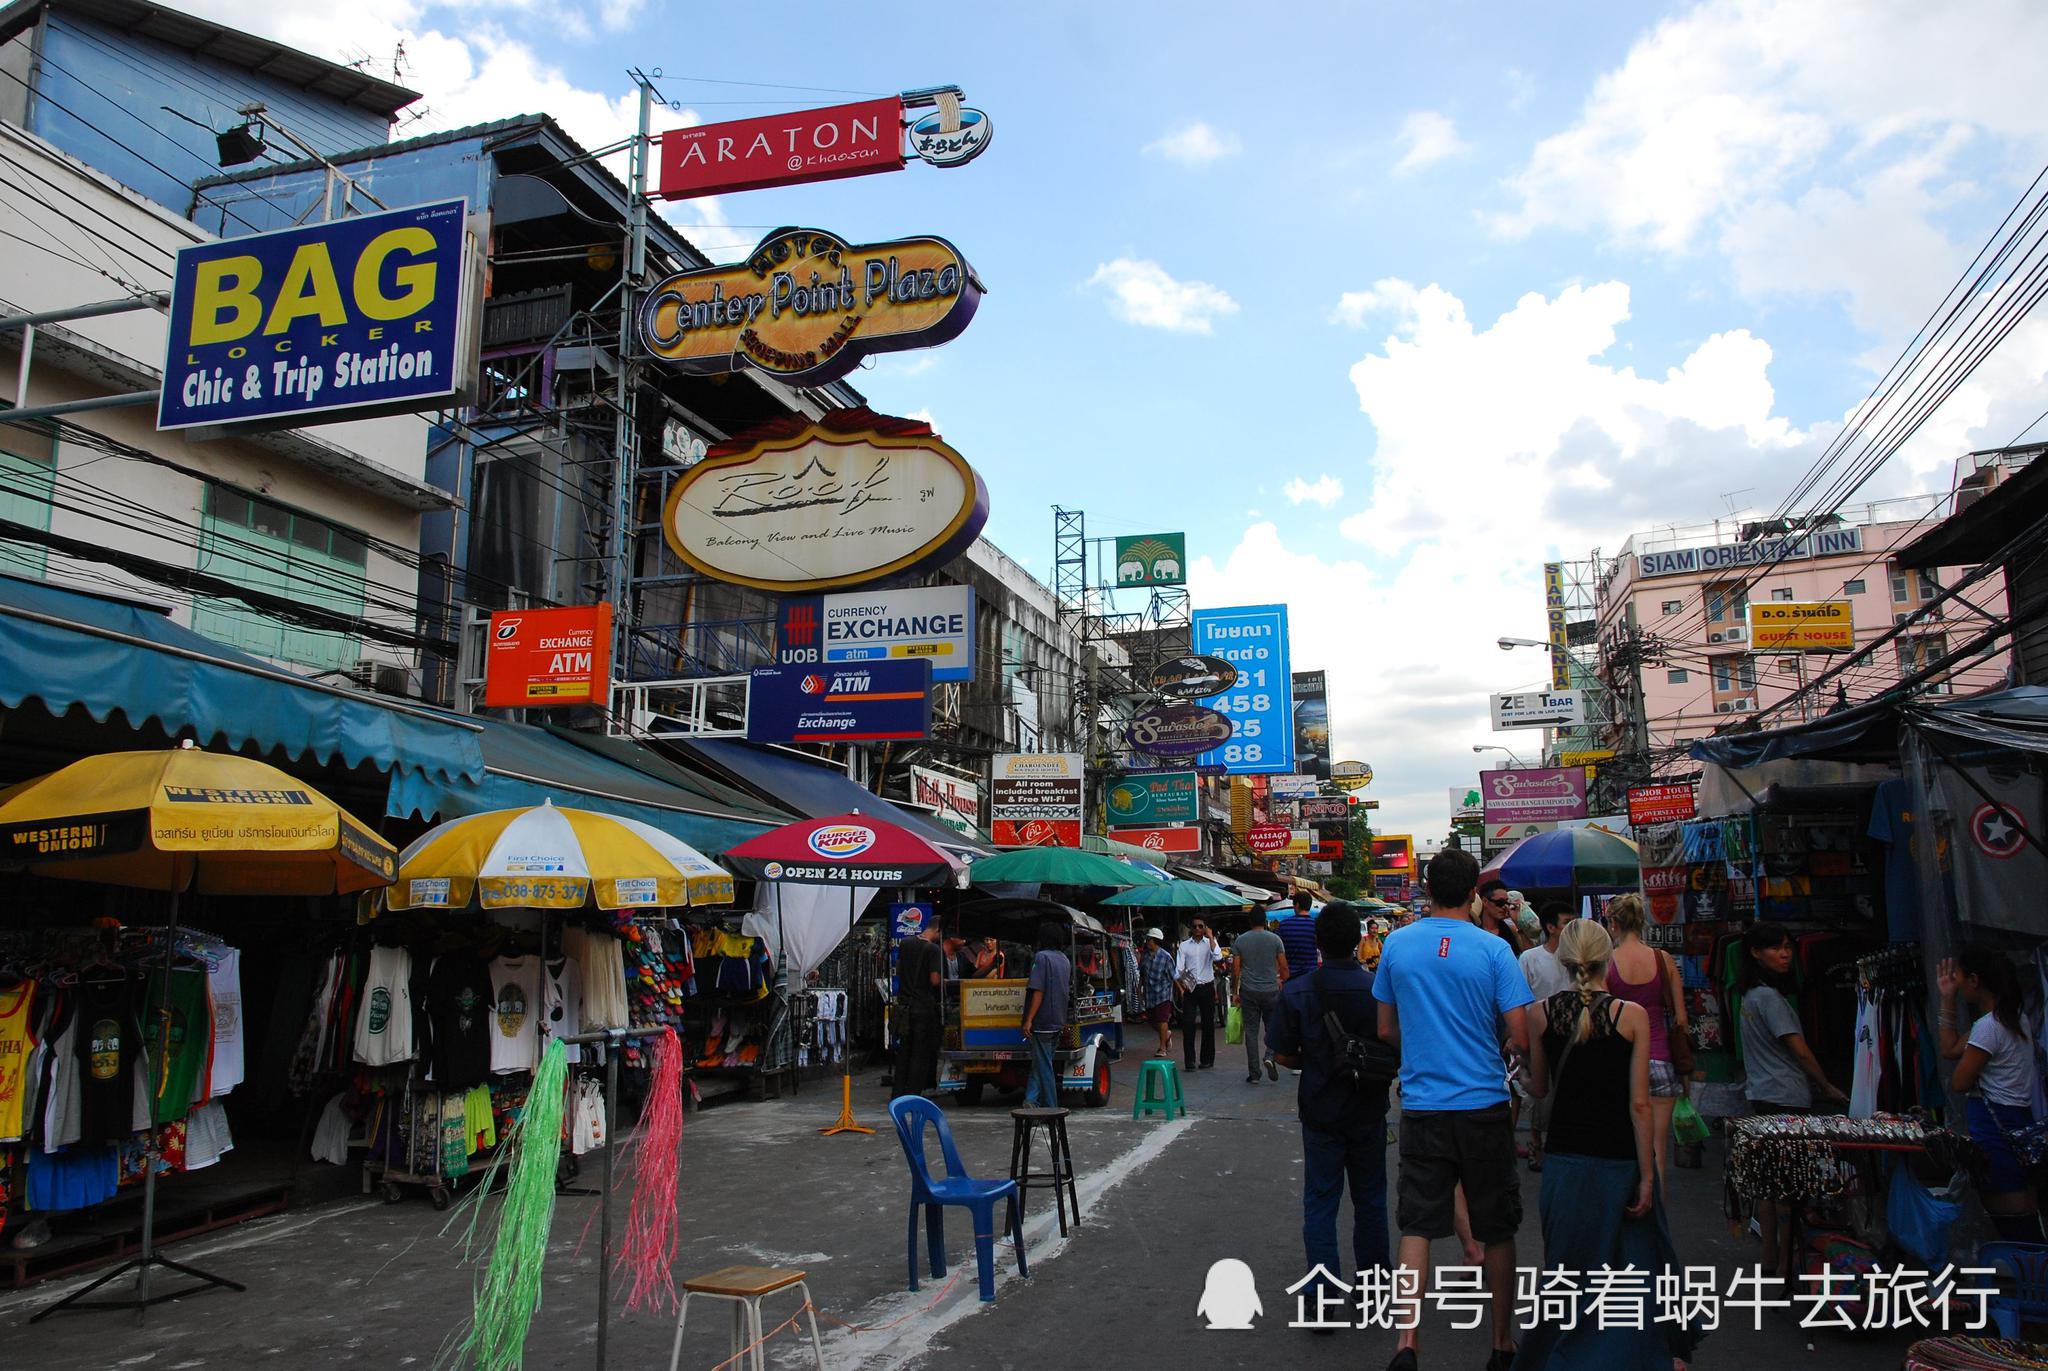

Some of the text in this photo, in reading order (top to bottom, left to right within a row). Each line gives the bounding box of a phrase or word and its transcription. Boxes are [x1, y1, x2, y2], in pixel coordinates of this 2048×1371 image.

[680, 116, 878, 168] ARATON
[919, 130, 980, 155] あらとん
[751, 235, 843, 280] HOTEL
[189, 226, 438, 347] BAG
[649, 256, 959, 349] Center Point Plaza
[187, 319, 434, 366] LOCKER
[182, 342, 433, 408] Chic & Trip Station
[705, 524, 915, 550] Balcony View and Live Music
[1642, 533, 1856, 573] SIAM ORIENTAL INN
[1545, 564, 1562, 605] SIAM
[828, 606, 888, 619] CURRENCY
[827, 614, 964, 640] EXCHANGE
[1206, 623, 1272, 640] โฆษณา
[540, 636, 593, 649] EXCHANGE
[1759, 631, 1847, 641] GUEST HOUSE
[782, 648, 818, 665] UOB
[845, 647, 869, 660] atm
[1549, 611, 1569, 691] ORIENTA
[548, 652, 592, 674] ATM
[829, 676, 871, 693] ATM
[1233, 669, 1266, 689] 81
[1212, 693, 1271, 714] 458
[1500, 694, 1574, 710] ZET BAR
[797, 717, 857, 730] Exchange
[1231, 719, 1262, 738] 25
[1223, 743, 1263, 763] 88
[166, 786, 285, 798] WESTERN
[1015, 780, 1028, 788] All
[1035, 787, 1078, 795] breakfast
[1492, 774, 1574, 797] Sawasdee
[1666, 785, 1691, 795] TOUR
[207, 796, 290, 804] UNION
[915, 776, 947, 816] Wally
[1488, 800, 1520, 808] SAWASDEE
[1643, 809, 1675, 817] OVERSEA
[1651, 814, 1686, 823] INTERNET
[13, 825, 93, 844] WESTERN
[155, 823, 335, 842] เวสเทิร์น ยูเนี่ยน บริการโอนเงินทั่วโลก
[818, 830, 868, 841] BURGER
[1249, 831, 1288, 841] MASSAGE
[38, 837, 93, 853] UNION
[817, 836, 867, 848] KING
[785, 867, 903, 881] OPEN 24 HOURS
[411, 879, 449, 888] First Choice
[616, 879, 656, 888] First Choice
